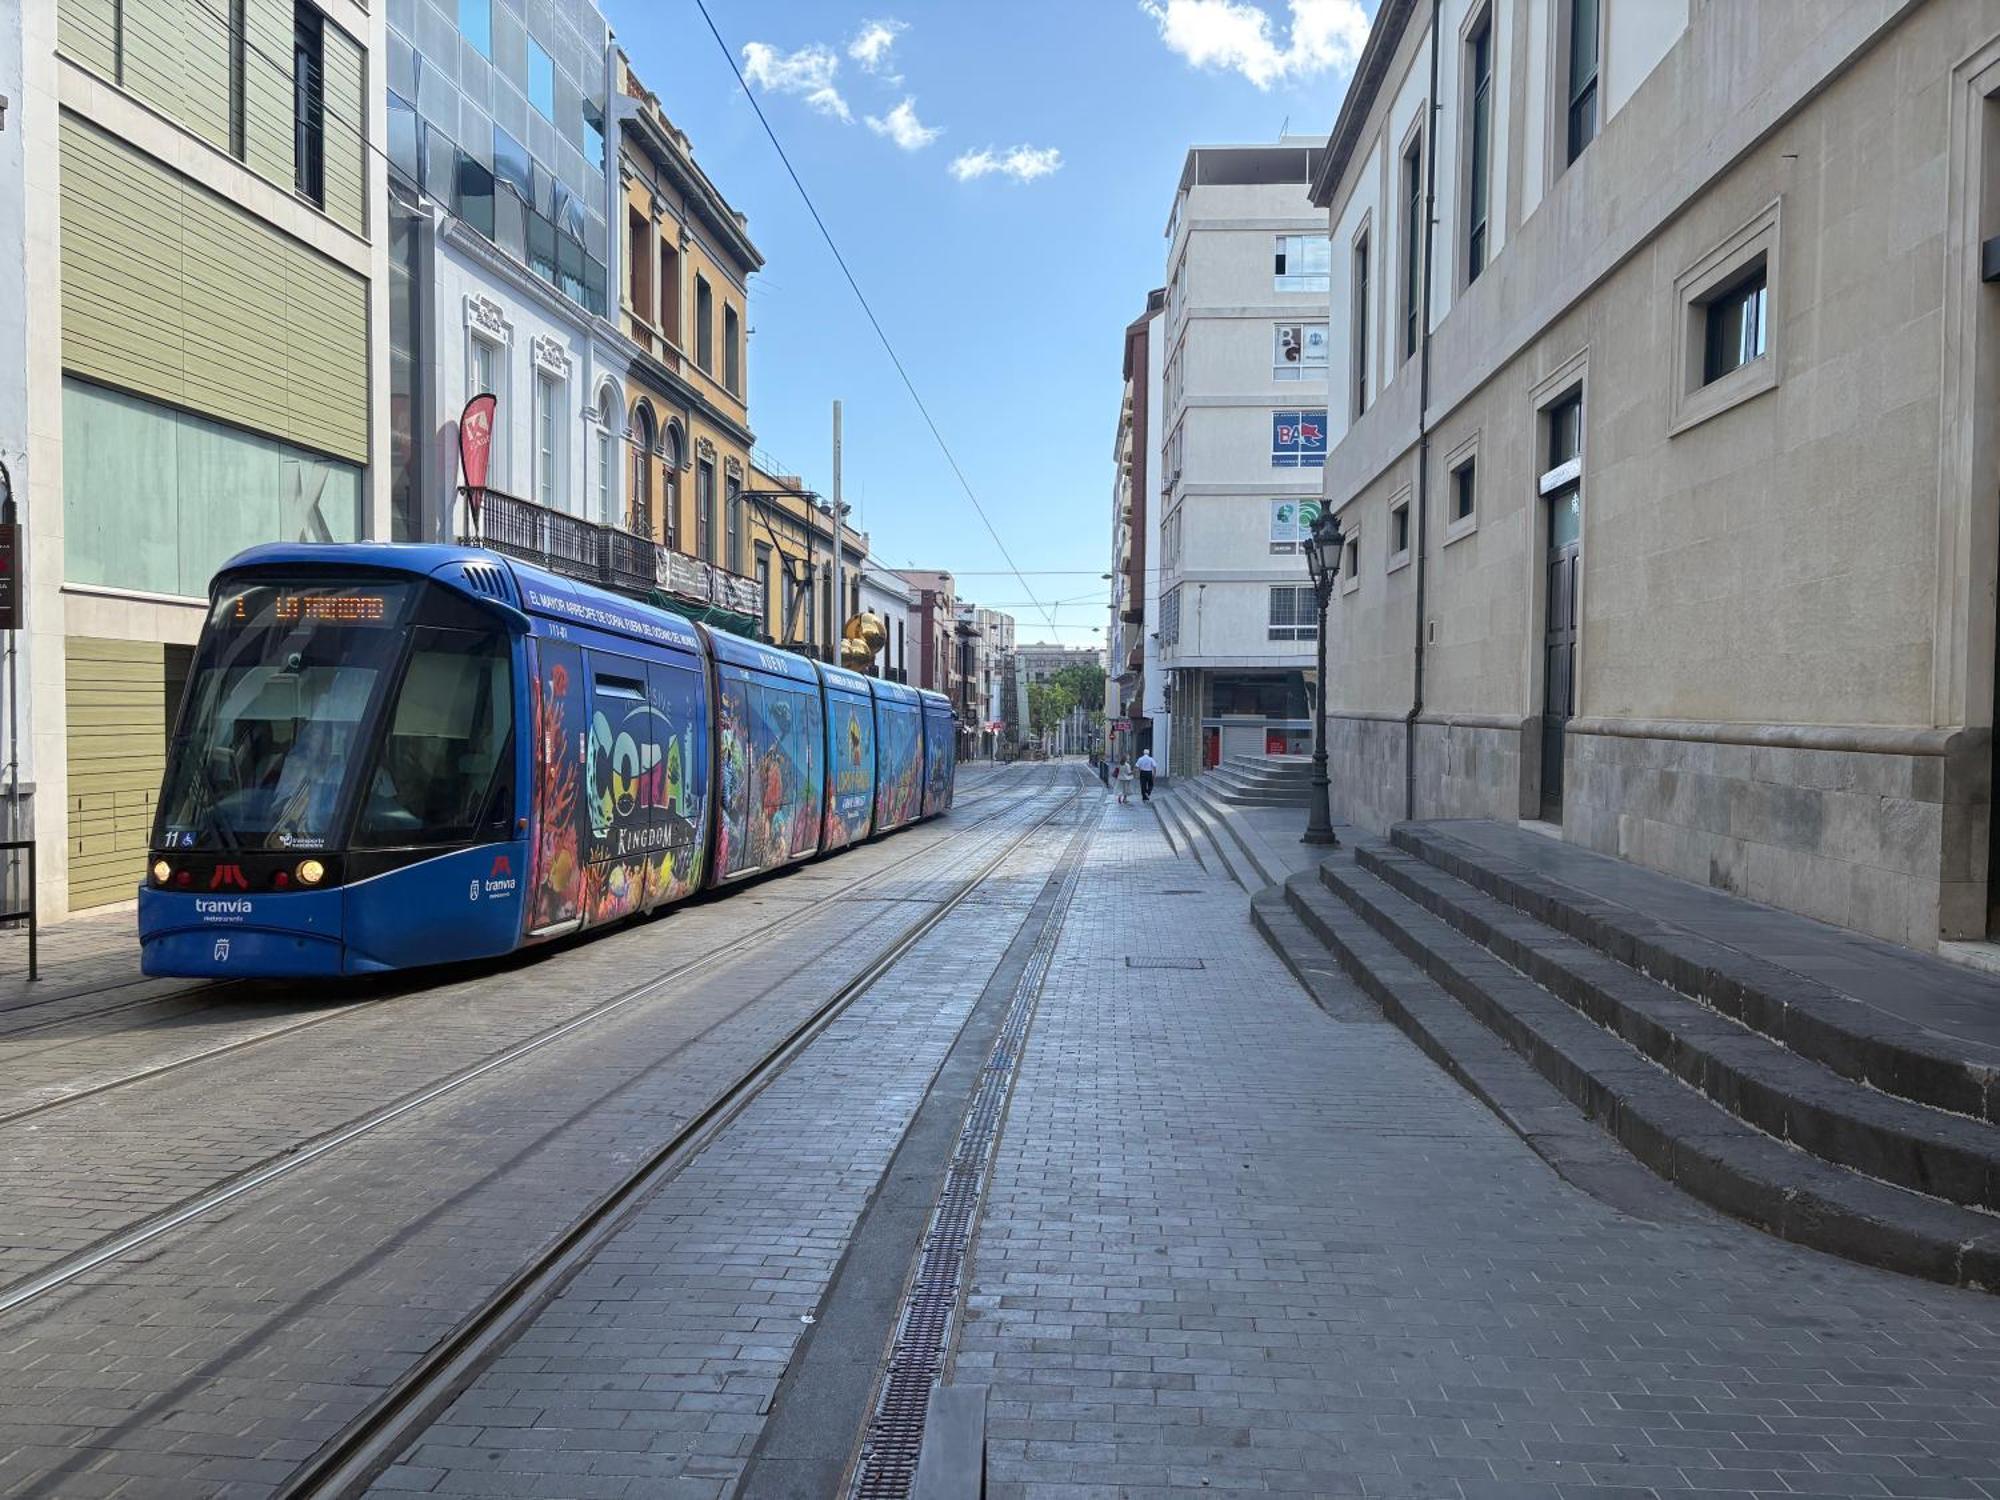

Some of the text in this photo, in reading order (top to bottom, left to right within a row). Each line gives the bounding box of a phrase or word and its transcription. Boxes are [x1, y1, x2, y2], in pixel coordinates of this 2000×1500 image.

[236, 594, 384, 619] 1 LA TRINIDAD
[165, 831, 178, 848] 11
[618, 823, 673, 855] KINGDOM
[195, 898, 253, 913] tranvía
